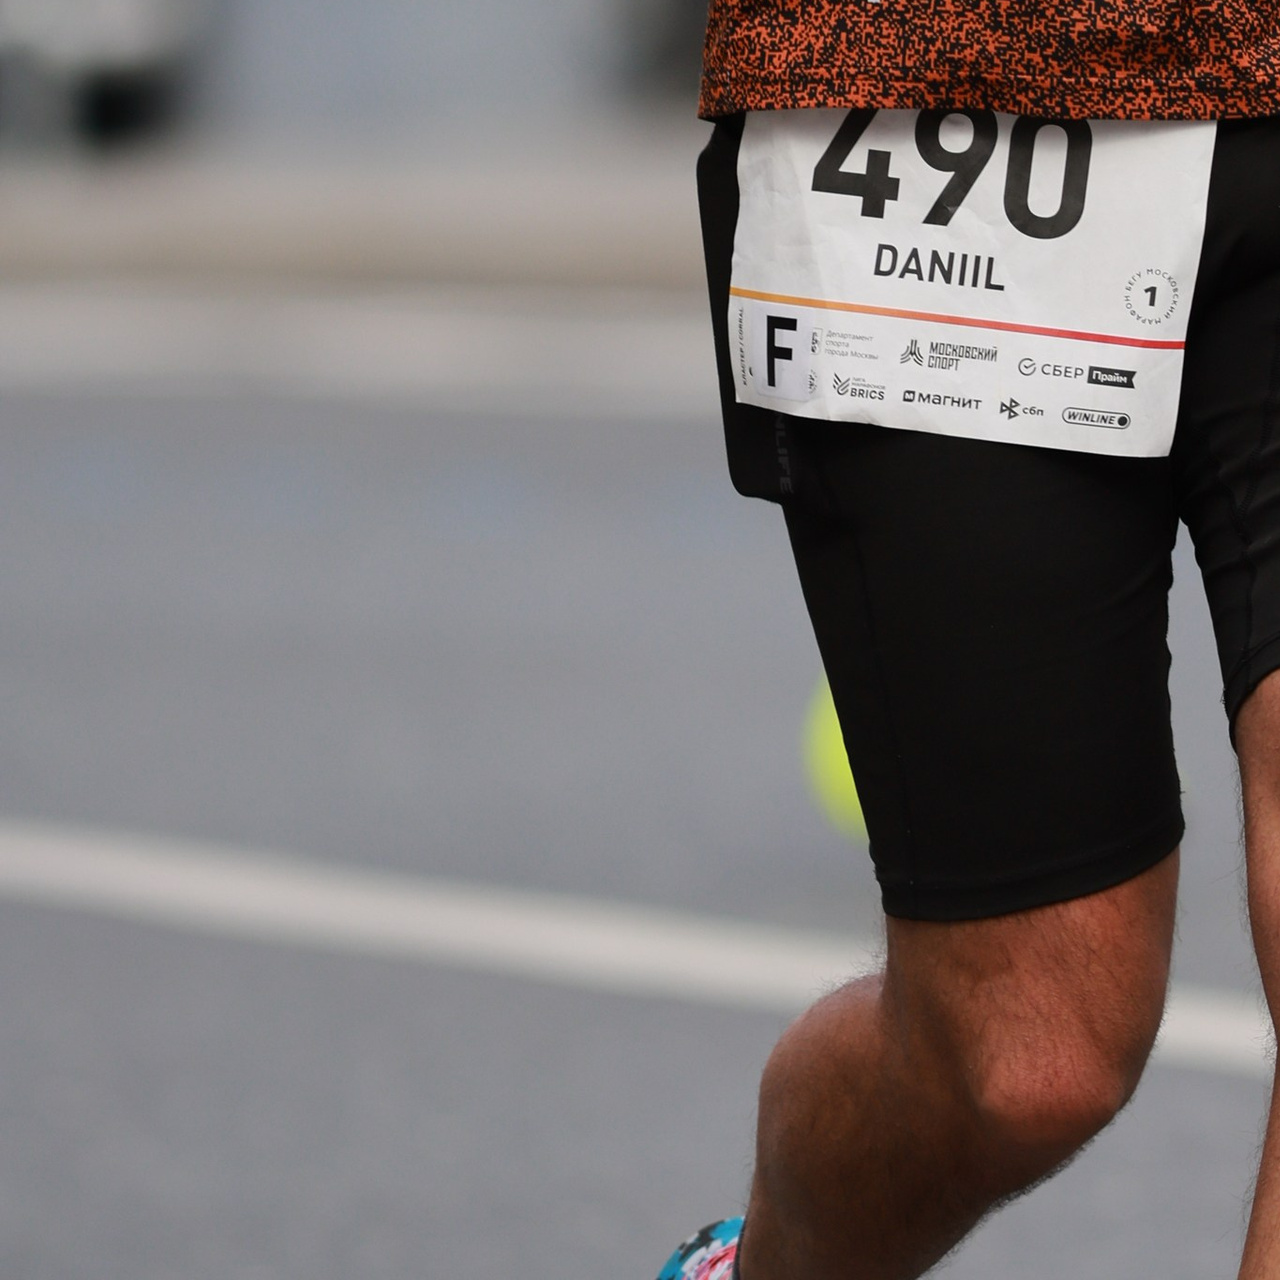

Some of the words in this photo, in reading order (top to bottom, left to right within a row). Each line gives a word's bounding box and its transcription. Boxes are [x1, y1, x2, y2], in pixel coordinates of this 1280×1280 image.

[811, 108, 1093, 240] 490
[873, 243, 1005, 292] DANIIL
[1143, 285, 1157, 307] 1
[766, 315, 798, 388] F
[929, 341, 998, 362] МОСКОВСКИЙ
[927, 355, 961, 371] СПОРТ
[1041, 363, 1084, 379] СБЕР
[1092, 370, 1128, 384] Прайм
[850, 387, 885, 401] BRICS
[1067, 410, 1116, 425] WINLINE
